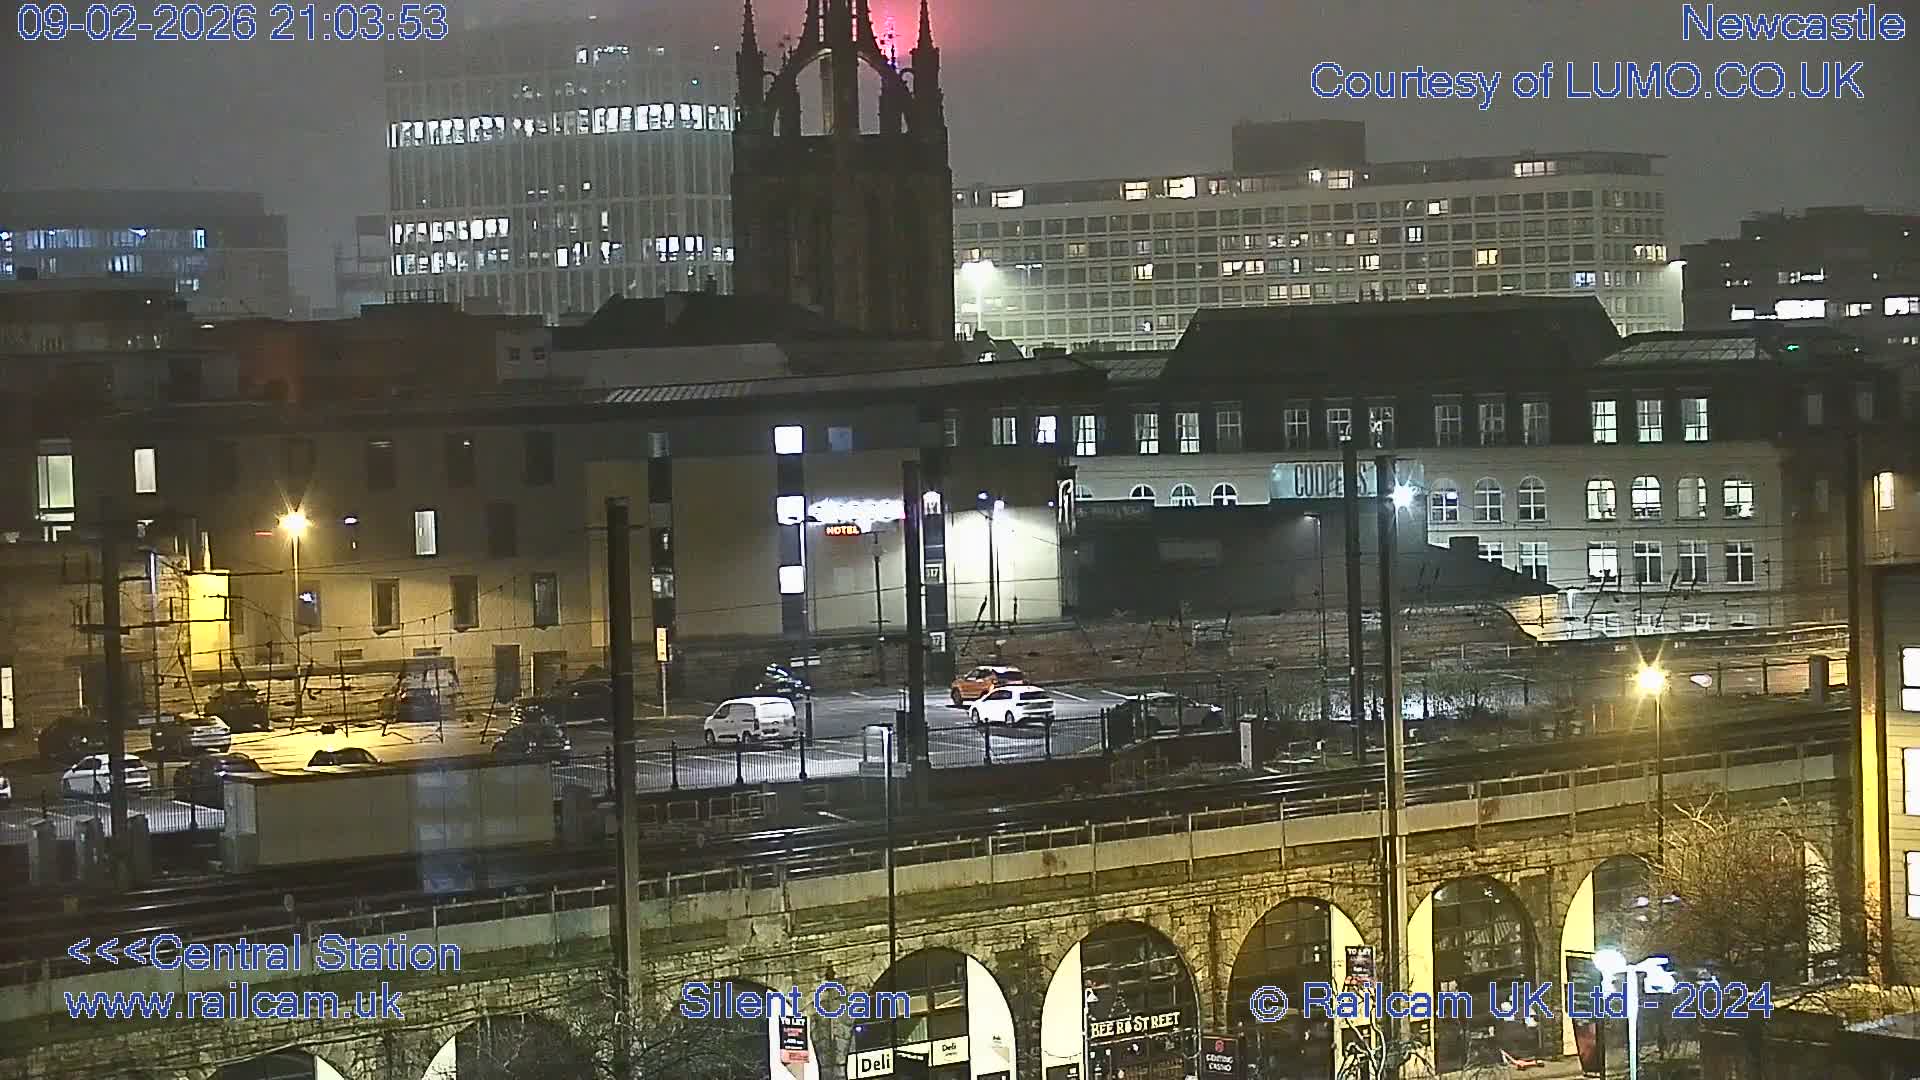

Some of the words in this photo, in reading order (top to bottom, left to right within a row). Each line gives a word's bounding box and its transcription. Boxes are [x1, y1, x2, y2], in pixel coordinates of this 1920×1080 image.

[1295, 463, 1367, 496] COOPES
[942, 1043, 957, 1052] Deli
[861, 1053, 891, 1073] Deli
